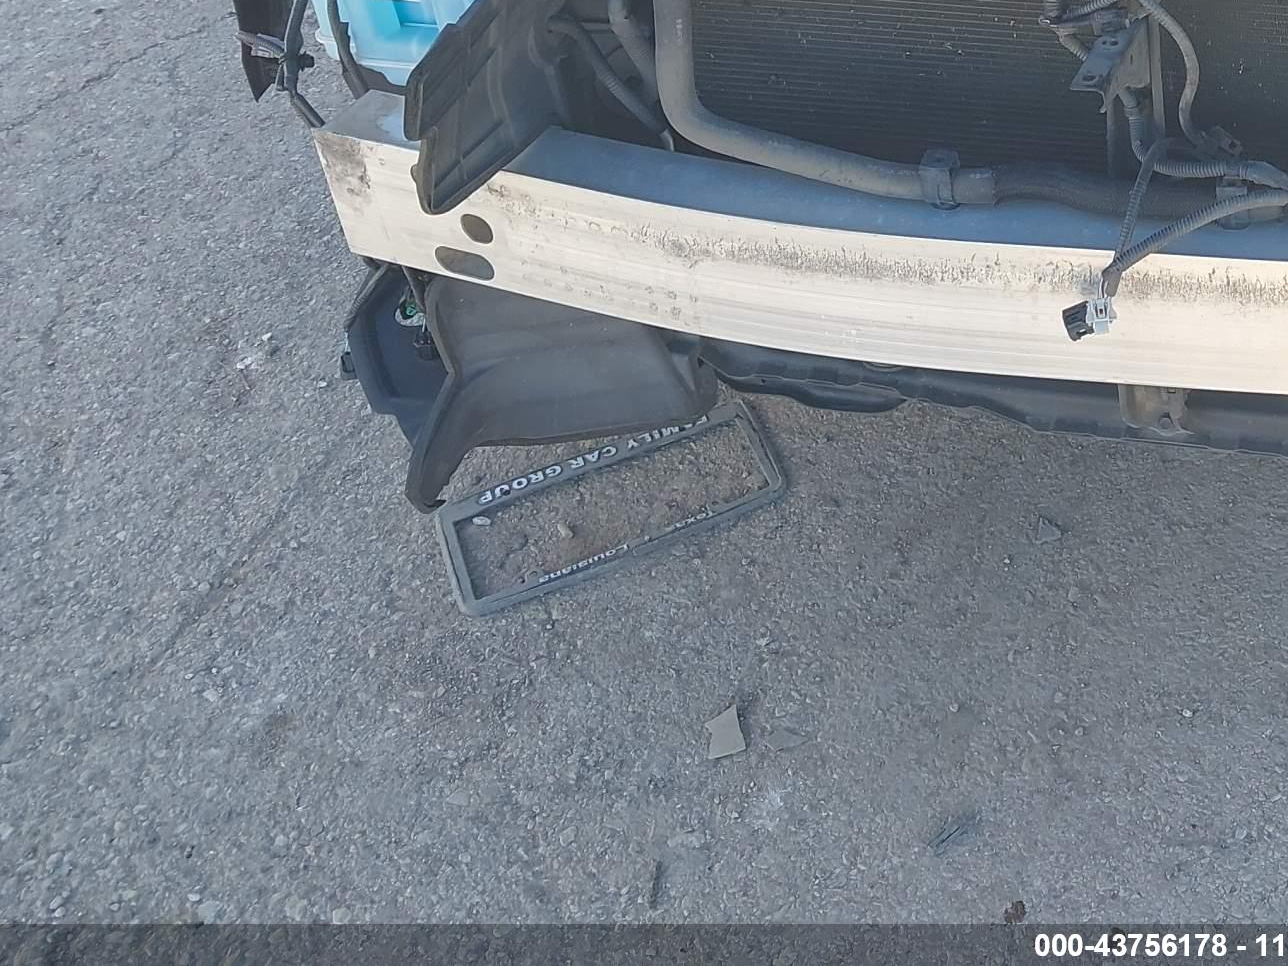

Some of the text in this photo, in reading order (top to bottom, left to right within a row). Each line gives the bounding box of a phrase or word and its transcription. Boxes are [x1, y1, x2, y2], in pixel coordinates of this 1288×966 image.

[569, 445, 618, 469] CAR
[478, 465, 562, 505] GROUP
[538, 543, 630, 583] Louisiana
